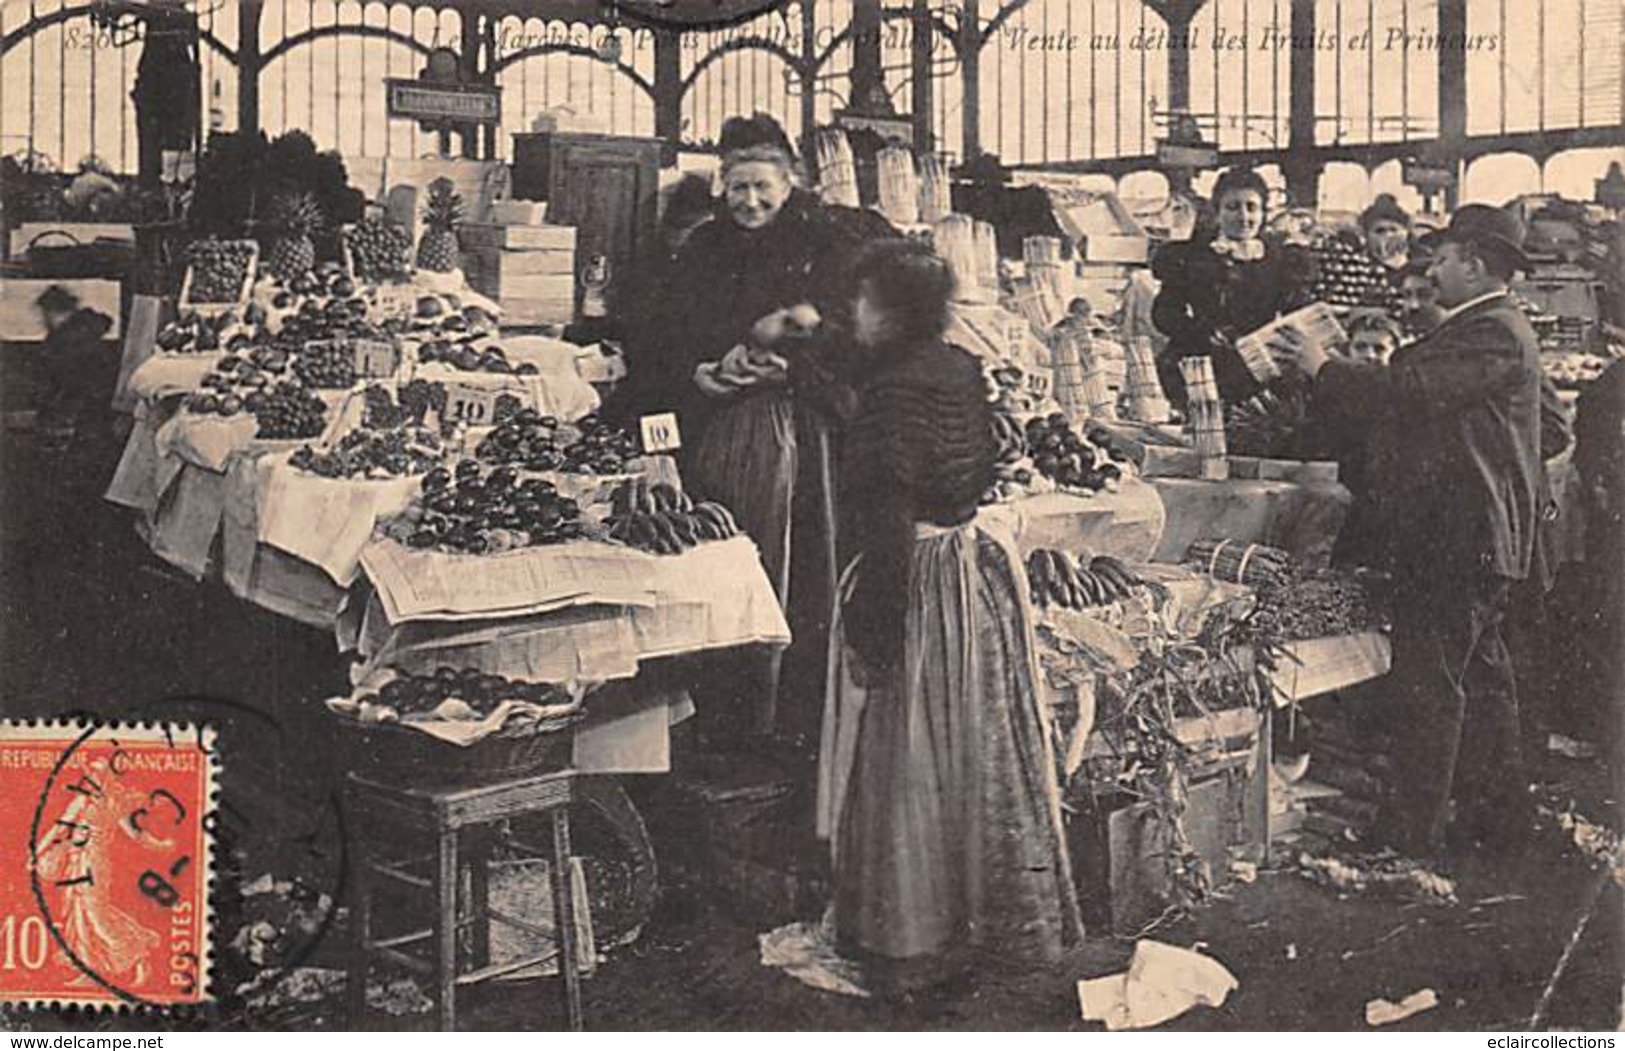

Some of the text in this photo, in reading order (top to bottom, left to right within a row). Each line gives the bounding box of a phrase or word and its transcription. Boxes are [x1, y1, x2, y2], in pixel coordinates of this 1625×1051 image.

[453, 400, 485, 420] 10
[649, 425, 669, 444] 10
[1, 915, 48, 970] 10
[170, 901, 192, 986] POSTES
